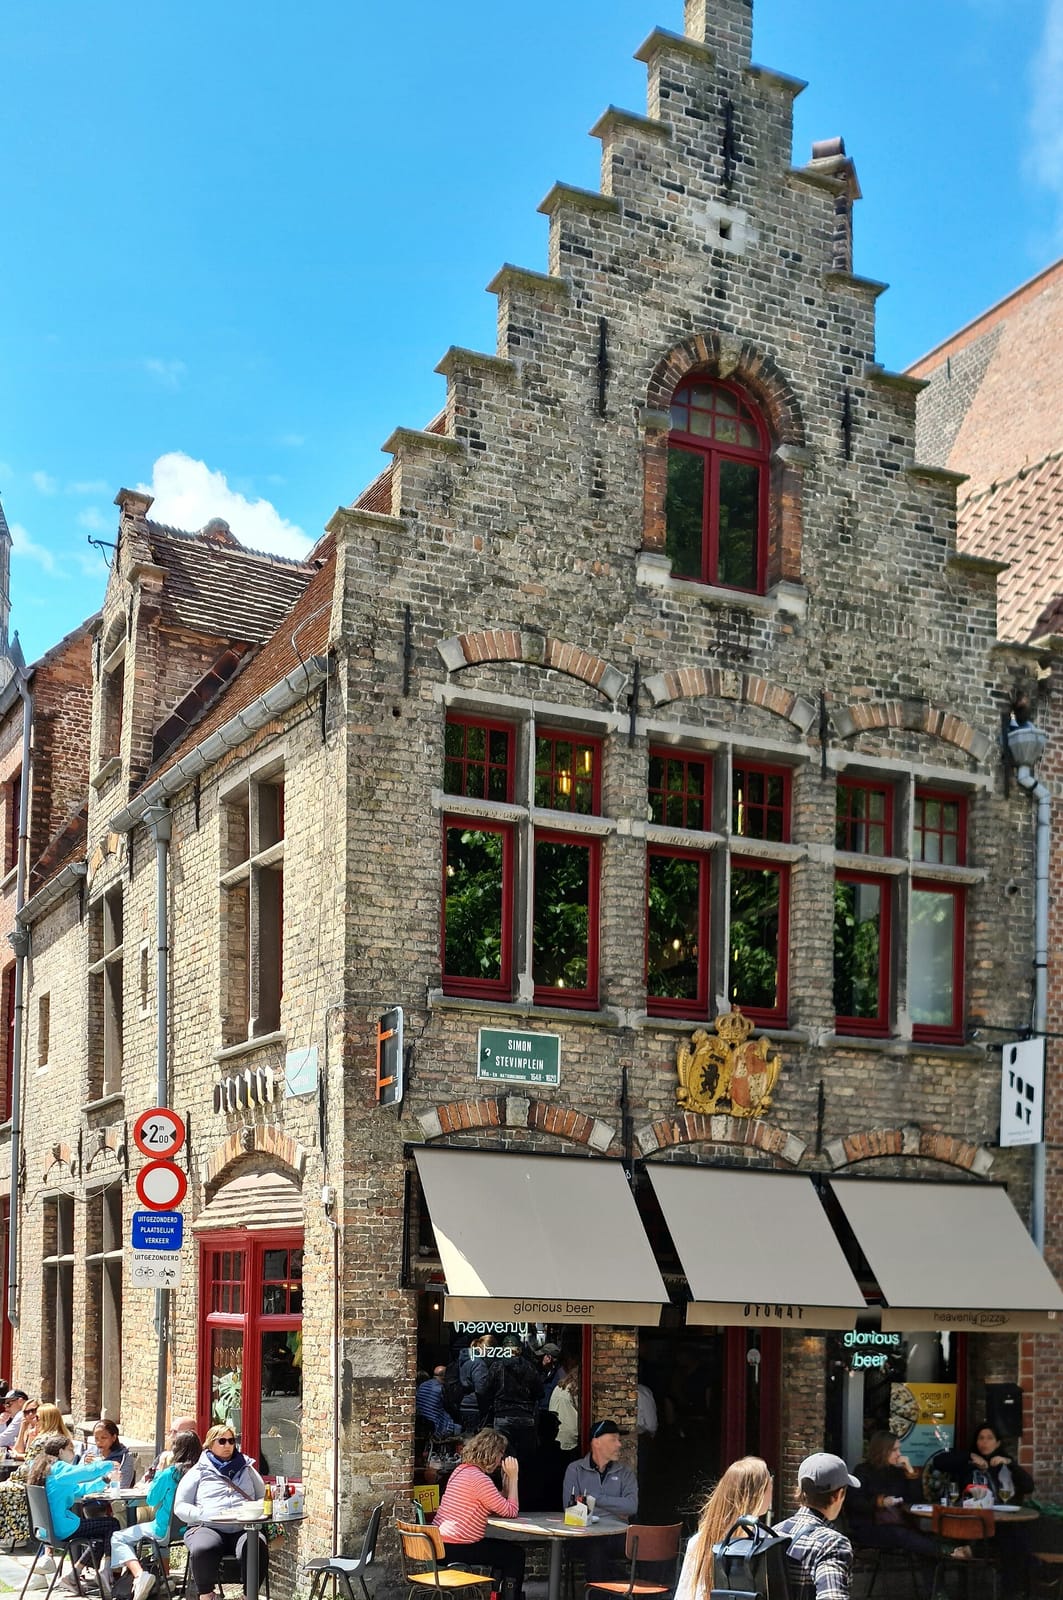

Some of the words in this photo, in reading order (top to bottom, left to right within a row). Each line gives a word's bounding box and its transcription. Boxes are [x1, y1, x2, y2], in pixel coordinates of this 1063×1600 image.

[508, 1040, 532, 1052] SIMON
[495, 1056, 544, 1070] STEVINPLEIN
[140, 1226, 175, 1234] PLAATSELIJK
[134, 1254, 179, 1262] UITGEZONDERD
[513, 1301, 563, 1315] glorious
[565, 1302, 595, 1313] beer
[933, 1312, 978, 1325] heavenly
[980, 1312, 1007, 1324] pizza
[453, 1320, 529, 1337] heavenly
[843, 1329, 900, 1347] glorious
[470, 1345, 513, 1361] pizza
[852, 1351, 888, 1368] beer
